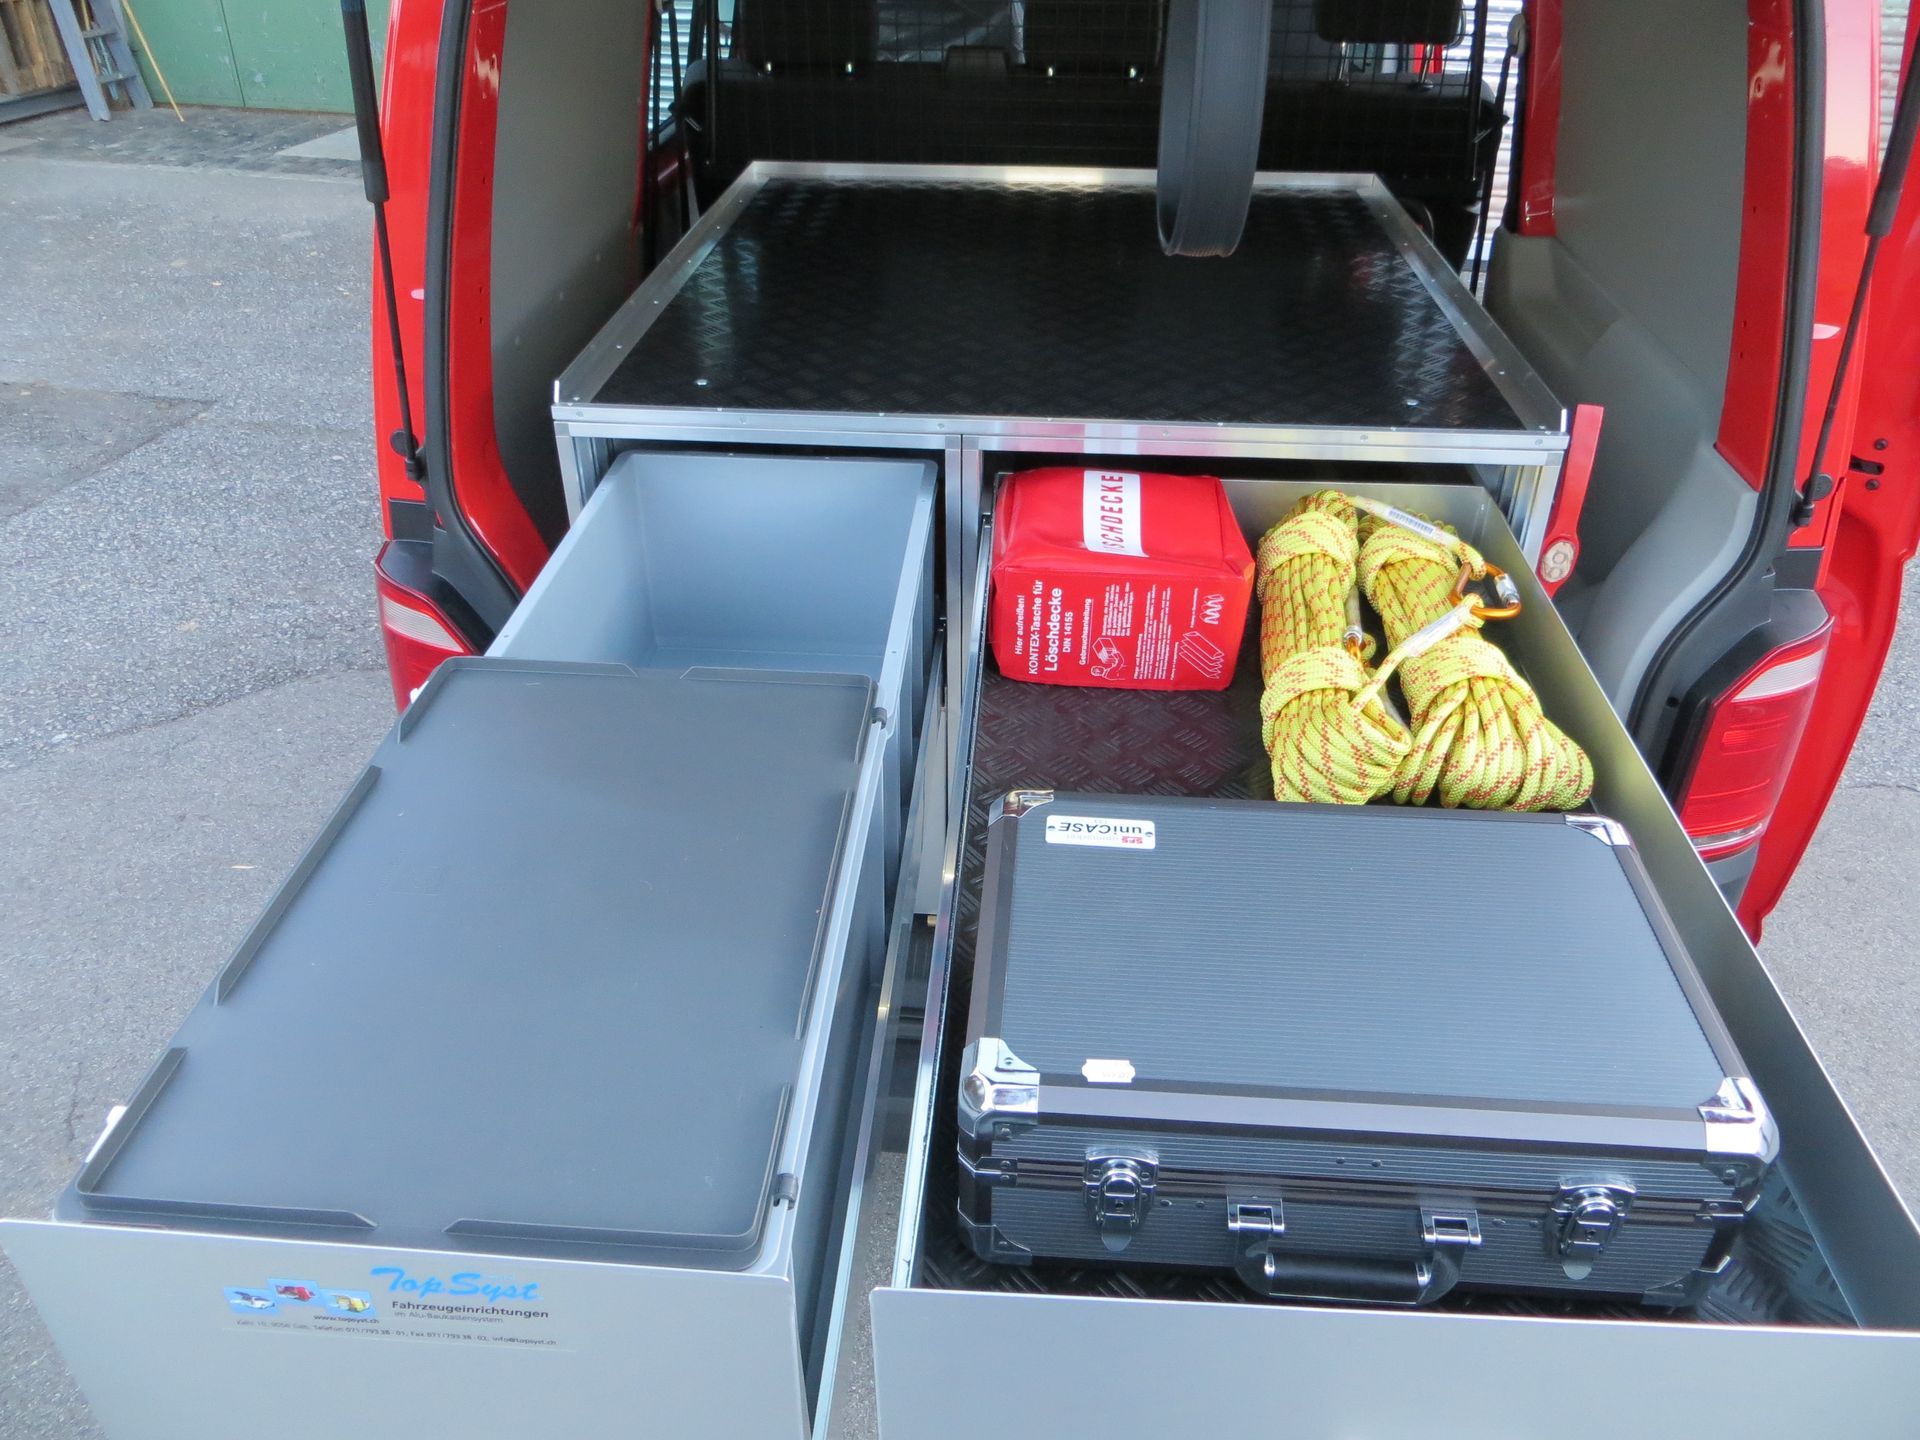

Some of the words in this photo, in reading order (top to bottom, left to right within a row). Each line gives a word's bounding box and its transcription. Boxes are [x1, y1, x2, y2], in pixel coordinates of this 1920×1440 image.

[1100, 474, 1125, 550] SCHDECKE
[1032, 580, 1043, 595] für
[1015, 595, 1025, 636] aufreißen!
[1044, 587, 1063, 672] Löschdecke
[1064, 611, 1073, 635] 14155
[1014, 637, 1023, 655] Hier
[1028, 597, 1042, 675] KONTEX-Tasche
[1063, 637, 1072, 653] DIN
[1078, 598, 1092, 665] Gebrauchsanleitung
[1058, 822, 1142, 834] uniCASE
[370, 1265, 542, 1302] TopSyst
[391, 1300, 549, 1319] Fahrzeugeinrichtungen
